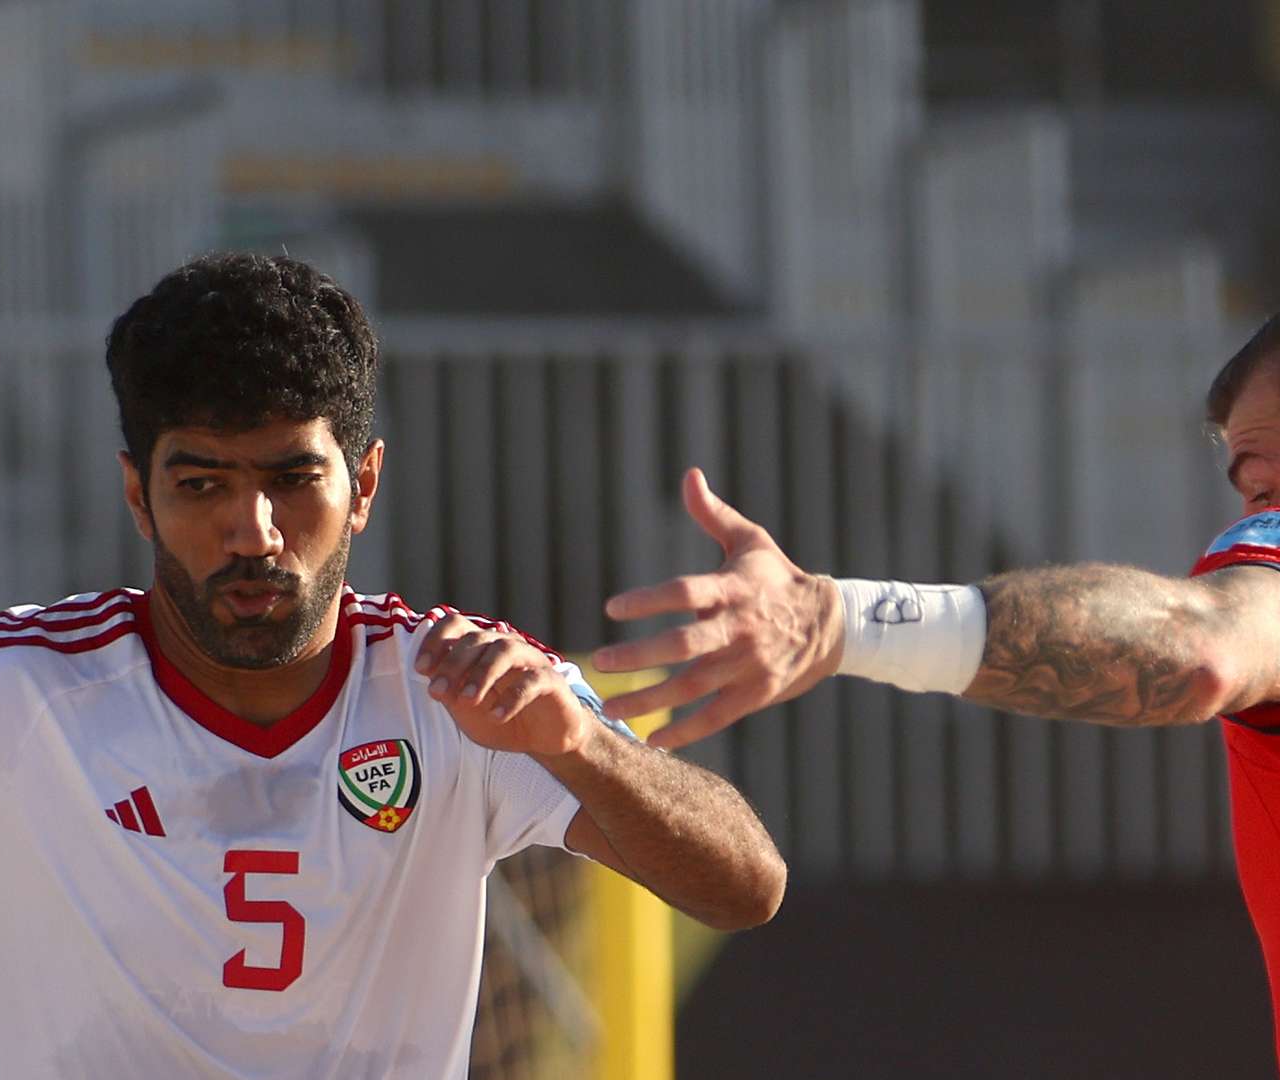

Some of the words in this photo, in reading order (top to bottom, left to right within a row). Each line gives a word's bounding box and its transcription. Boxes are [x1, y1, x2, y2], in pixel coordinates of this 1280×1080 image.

[355, 762, 395, 782] UAE
[368, 779, 391, 793] FA
[222, 849, 306, 992] 5
